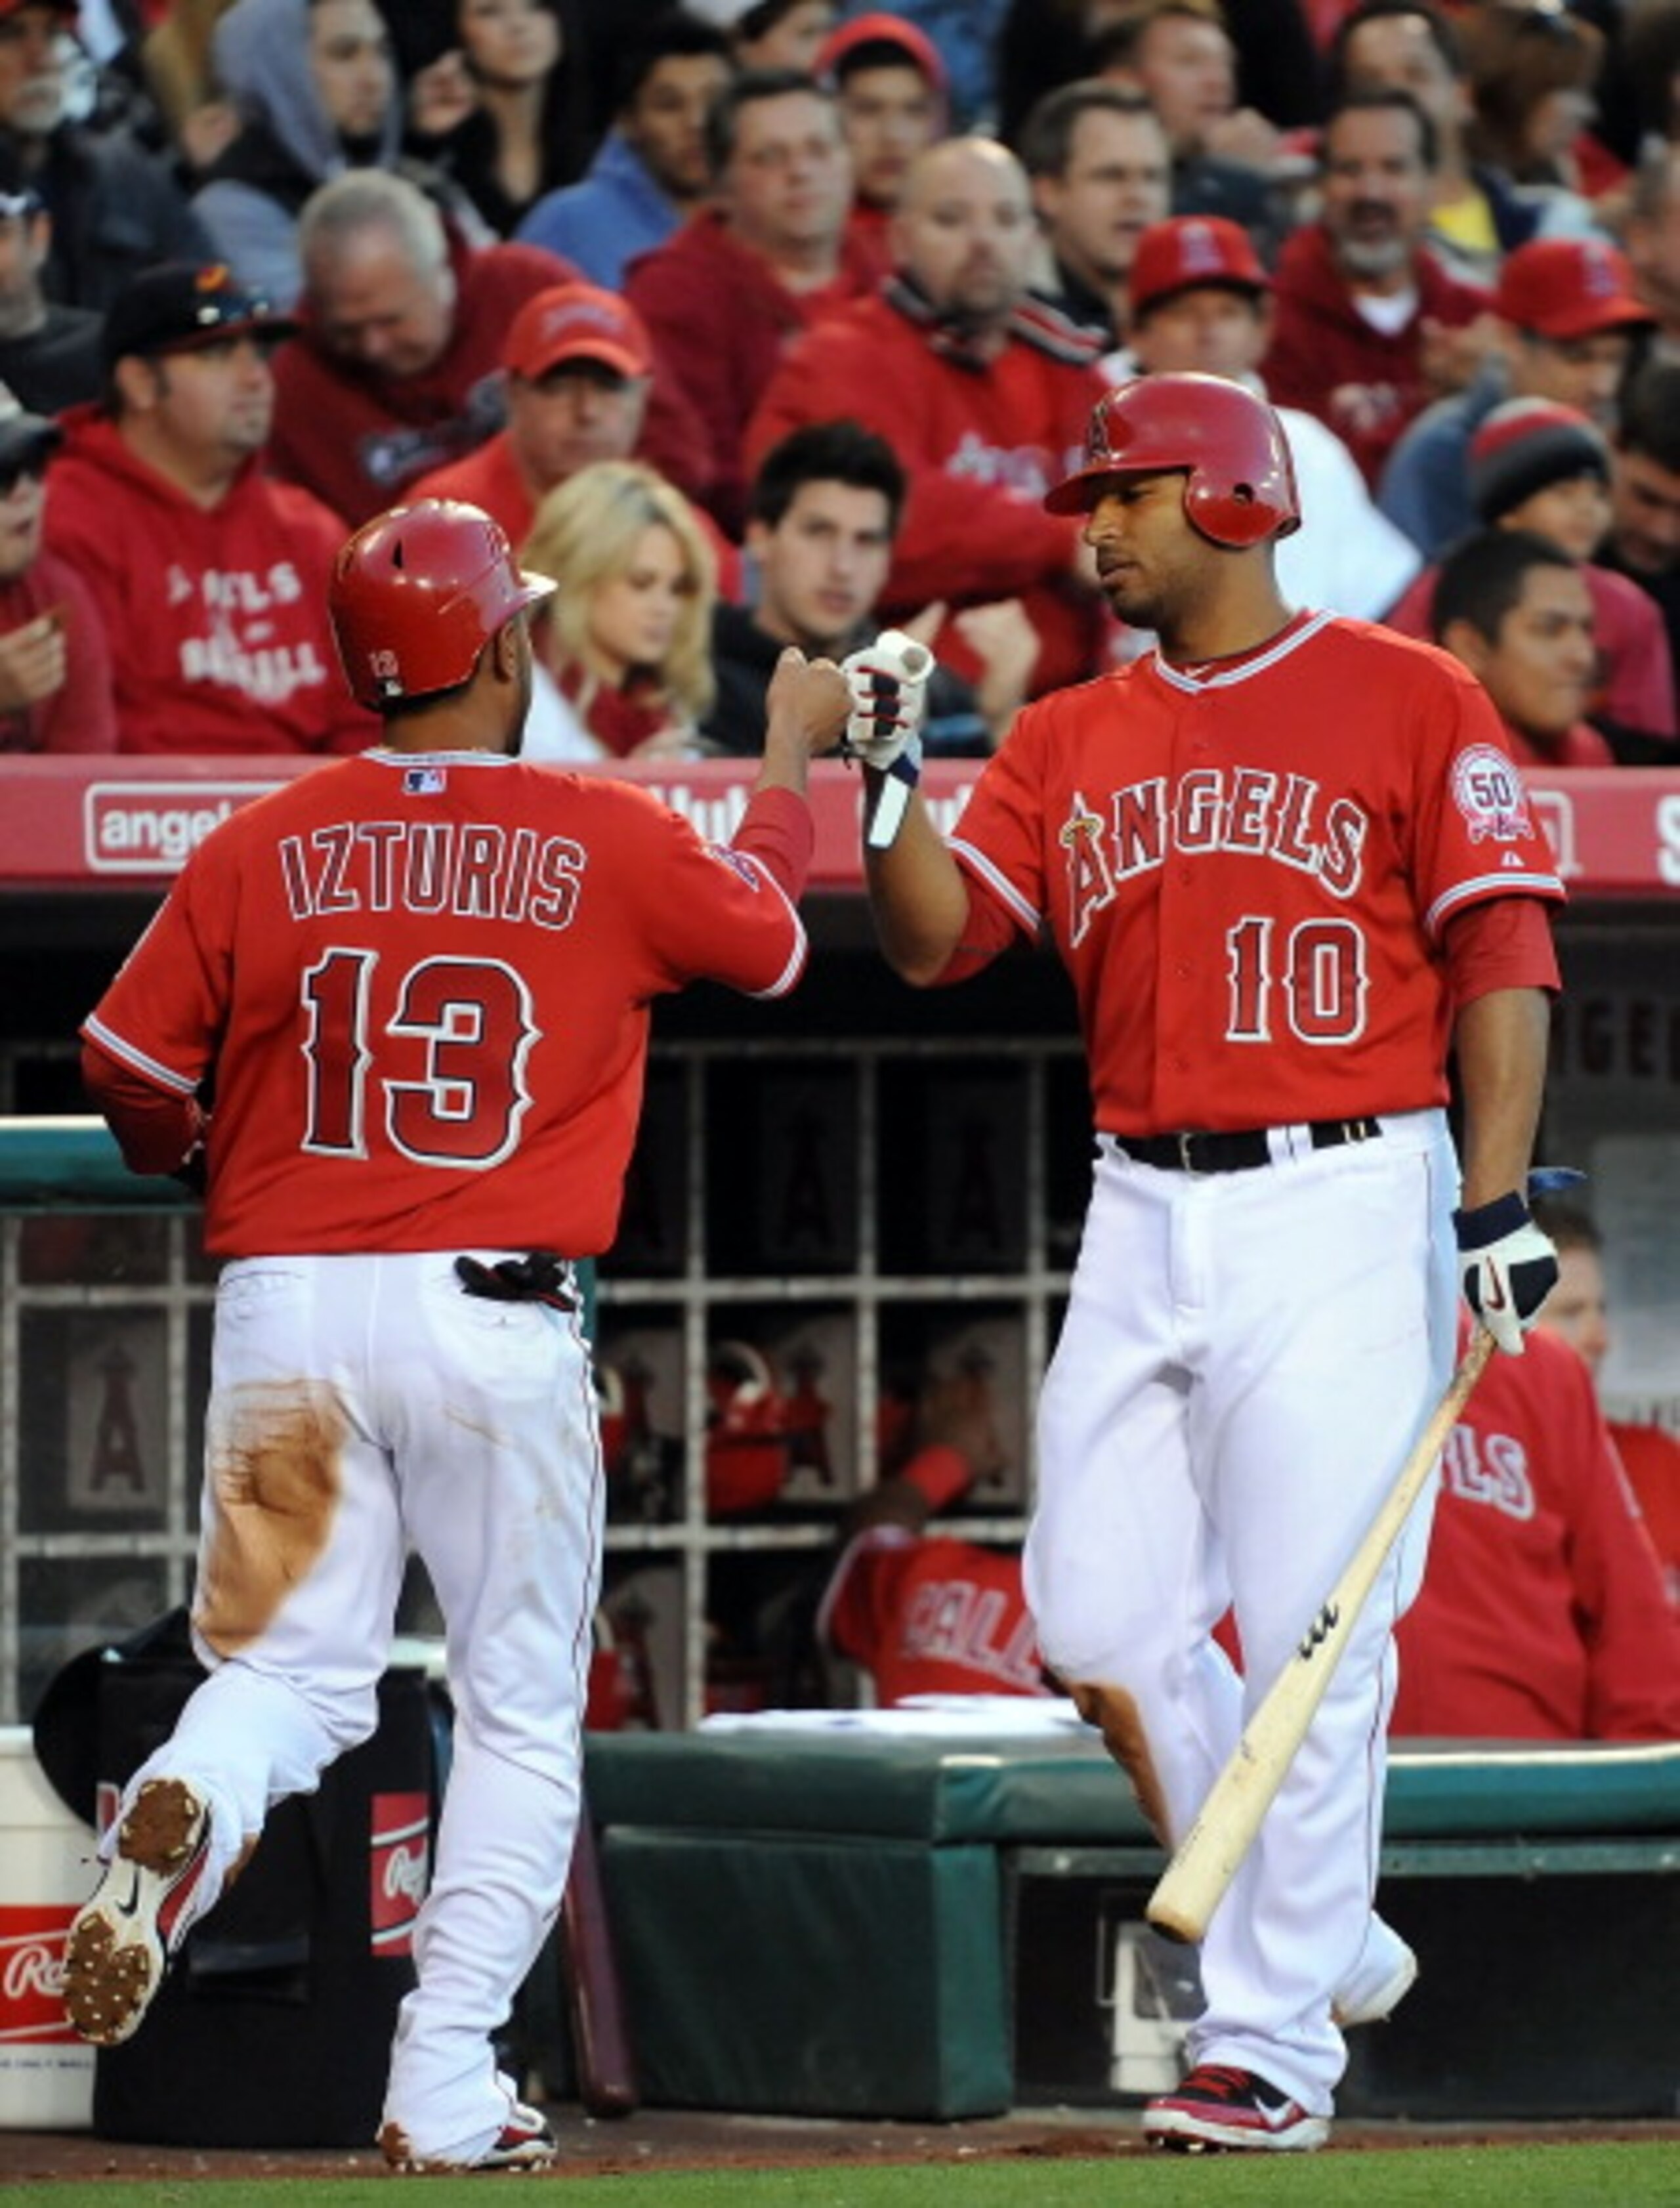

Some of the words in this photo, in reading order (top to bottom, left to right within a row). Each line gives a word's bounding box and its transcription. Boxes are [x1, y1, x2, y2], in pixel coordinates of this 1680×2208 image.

[1470, 772, 1513, 808] 50
[278, 820, 587, 931] IZTURIS
[1059, 765, 1368, 949] ANGELS
[1225, 916, 1372, 1046] 10
[300, 945, 543, 1172] 13
